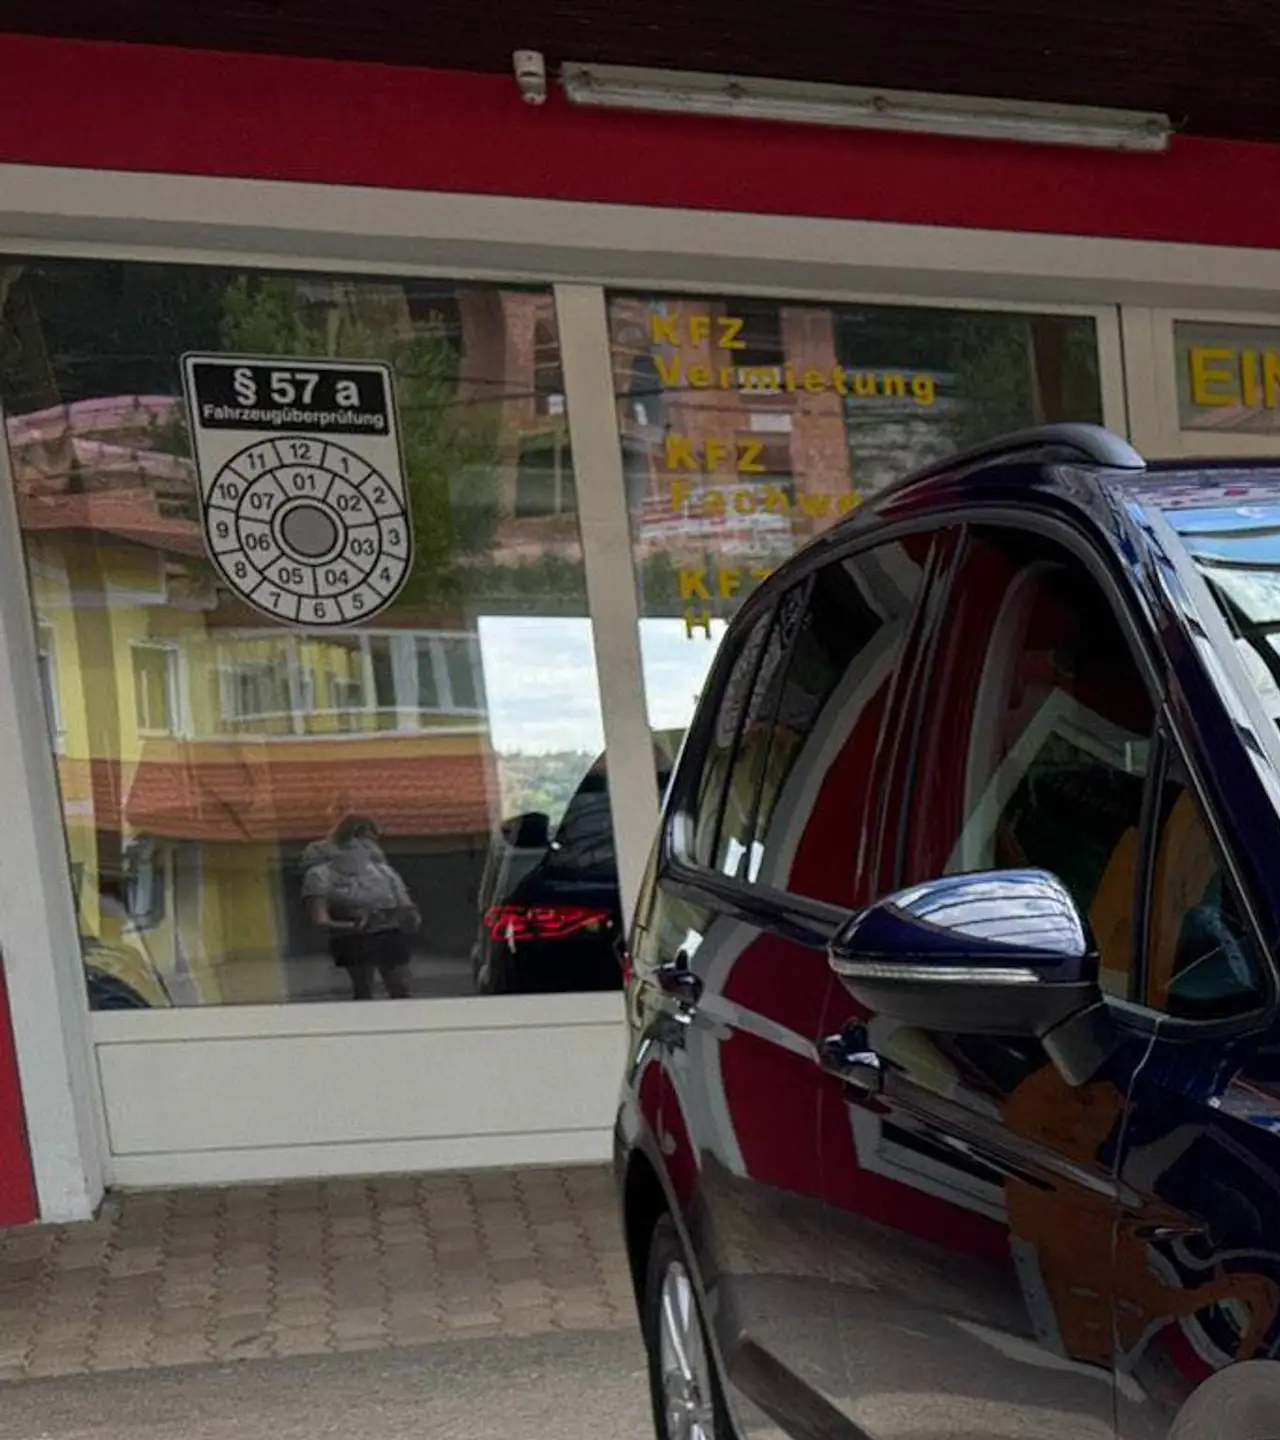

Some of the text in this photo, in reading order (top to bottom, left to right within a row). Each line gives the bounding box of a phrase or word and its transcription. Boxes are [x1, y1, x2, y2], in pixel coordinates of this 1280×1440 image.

[651, 313, 747, 350] KFZ
[233, 367, 361, 407] § 57 a
[654, 355, 937, 406] Vermietung
[203, 404, 385, 429] Fahrzeugüberprüfung
[289, 442, 311, 460] 12
[665, 433, 766, 474] KFZ
[248, 452, 267, 470] 11
[340, 457, 351, 473] 1
[292, 473, 316, 491] 01
[218, 483, 239, 501] 10
[373, 488, 386, 505] 2
[250, 493, 274, 510] 07
[337, 495, 362, 512] 02
[216, 521, 229, 538] 9
[388, 528, 400, 546] 3
[245, 533, 270, 550] 06
[350, 538, 375, 556] 03
[235, 561, 247, 579] 8
[278, 568, 303, 584] 05
[325, 569, 349, 585] 04
[379, 567, 392, 583] 4
[269, 592, 281, 609] 7
[353, 593, 364, 610] 5
[313, 602, 326, 618] 6
